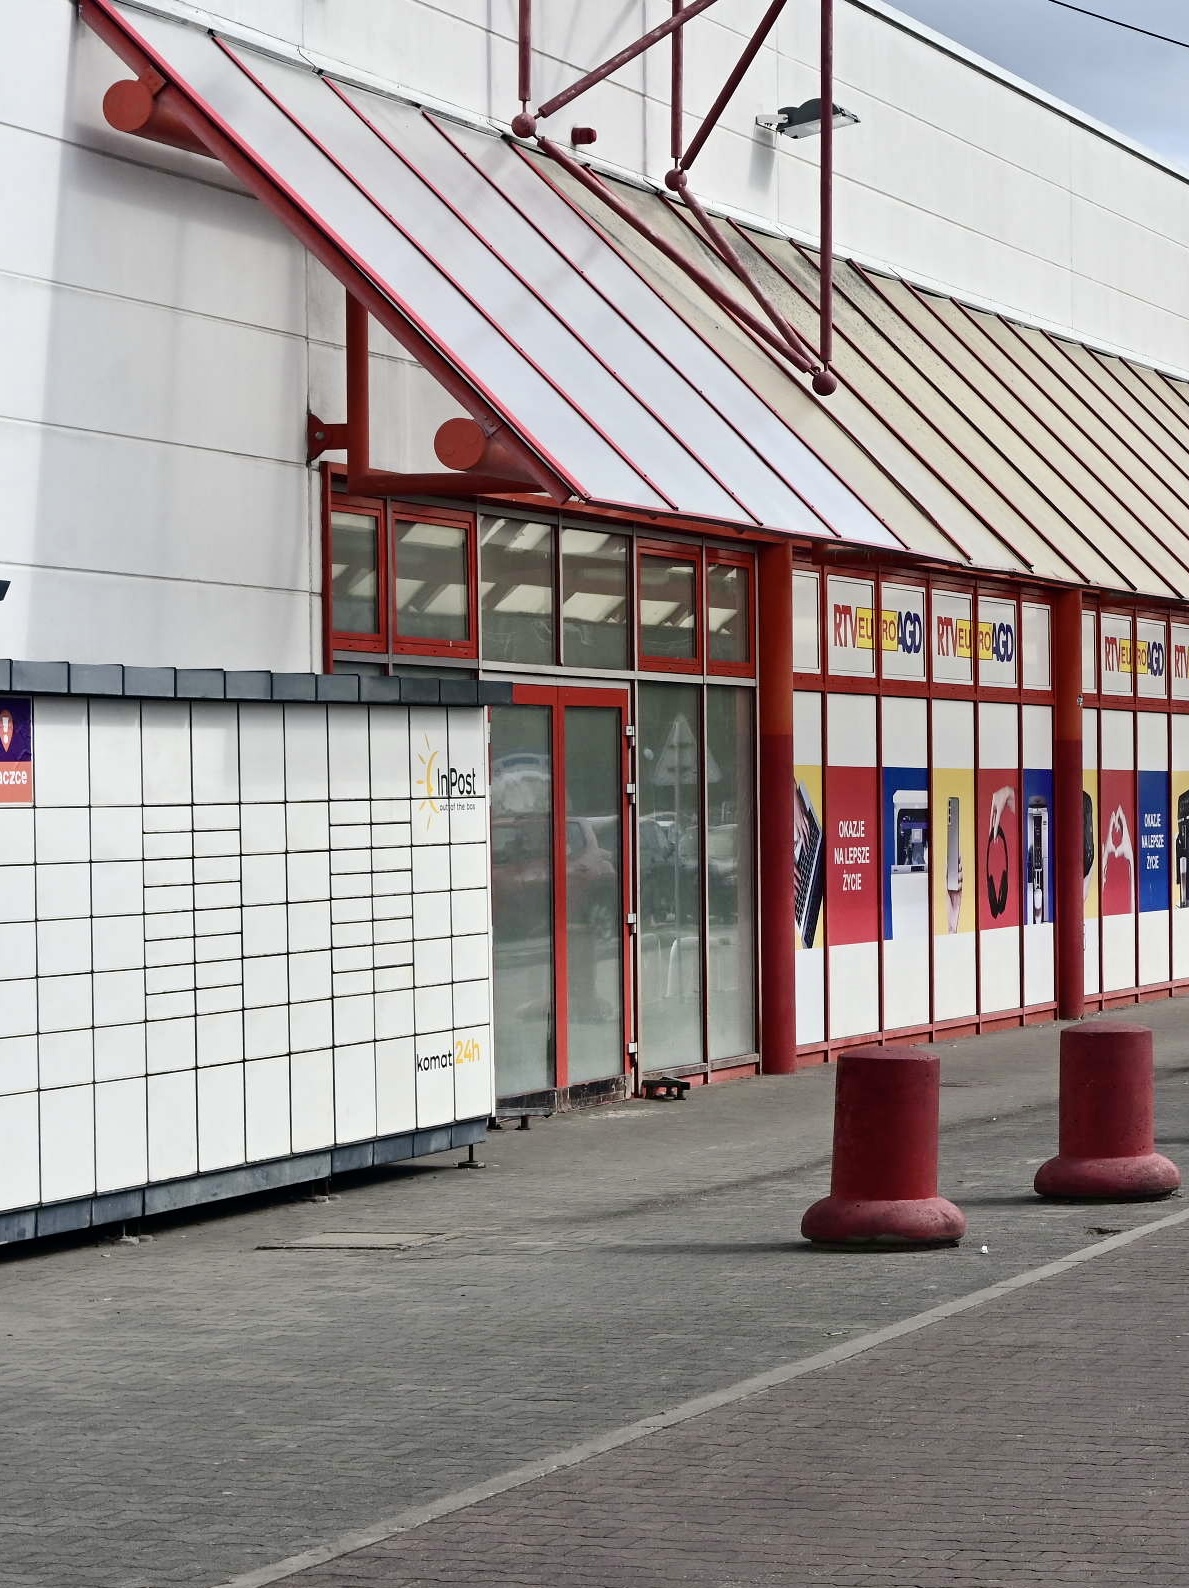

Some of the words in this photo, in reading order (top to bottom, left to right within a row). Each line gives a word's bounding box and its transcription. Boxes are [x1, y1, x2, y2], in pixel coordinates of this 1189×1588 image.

[833, 604, 858, 648] RTV
[858, 616, 897, 642] EURO
[897, 610, 923, 654] AGD
[937, 615, 958, 657] RTV
[958, 627, 991, 652] EURO
[992, 622, 1014, 663] AGD
[1105, 636, 1120, 672] RTV
[1147, 641, 1164, 677] AGD
[1174, 644, 1189, 679] RTV
[437, 767, 476, 796] InPost
[457, 802, 466, 811] the
[838, 820, 865, 838] OKAZJE
[834, 847, 844, 865] NA
[844, 846, 870, 864] LEPSZE
[842, 869, 862, 892] ŻYCIE
[417, 1049, 453, 1072] komat
[456, 1038, 480, 1064] 24h
